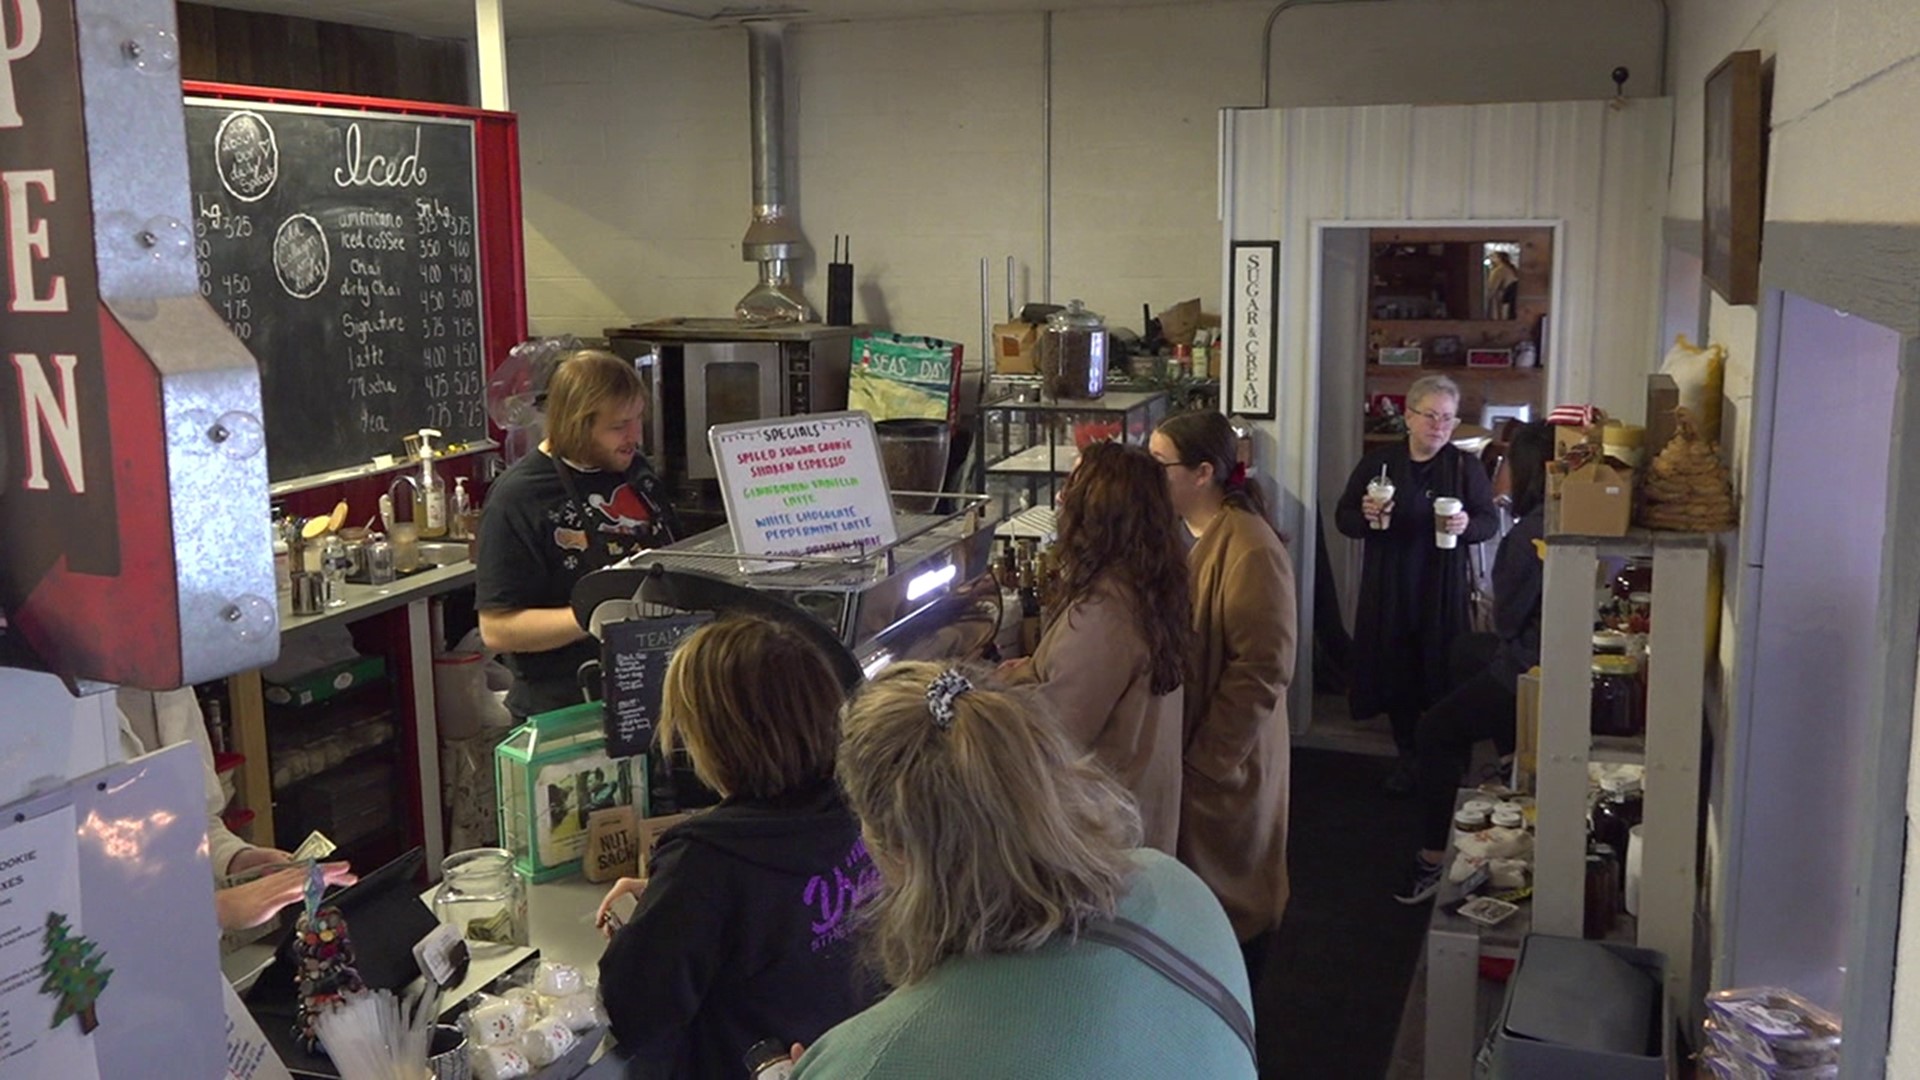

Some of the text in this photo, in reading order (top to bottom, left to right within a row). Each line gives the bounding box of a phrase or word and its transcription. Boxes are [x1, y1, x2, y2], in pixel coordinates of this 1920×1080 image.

[334, 122, 427, 187] Iced
[223, 216, 252, 238] 325
[338, 211, 403, 228] americano
[450, 215, 471, 236] 375
[419, 239, 441, 259] 350
[222, 273, 251, 294] 450
[420, 264, 442, 283] 400
[450, 263, 472, 283] 450
[340, 277, 371, 307] dirty
[420, 290, 445, 313] 450
[452, 289, 474, 309] 500
[1245, 254, 1260, 325] SUGAR
[223, 299, 251, 319] 475
[227, 321, 252, 340] 00
[423, 316, 445, 339] 375
[423, 345, 446, 368] 400
[453, 342, 477, 367] 450
[872, 353, 951, 379] SEAS DAY
[425, 373, 449, 398] 475
[454, 370, 480, 396] 525
[1243, 340, 1260, 409] CREAM
[427, 402, 451, 428] 275
[458, 401, 482, 428] 325
[763, 424, 821, 441] SPECIALS
[737, 448, 777, 465] SPICED
[780, 444, 815, 457] SUGAR
[799, 456, 847, 471] ESPRESSO
[811, 477, 859, 490] VANILLA
[782, 494, 817, 508] LATTE
[756, 506, 857, 529] WHITE CHOCOLATE
[765, 517, 873, 542] PEPPERMINT LATTE
[599, 829, 628, 852] NUT
[0, 875, 24, 892] XES
